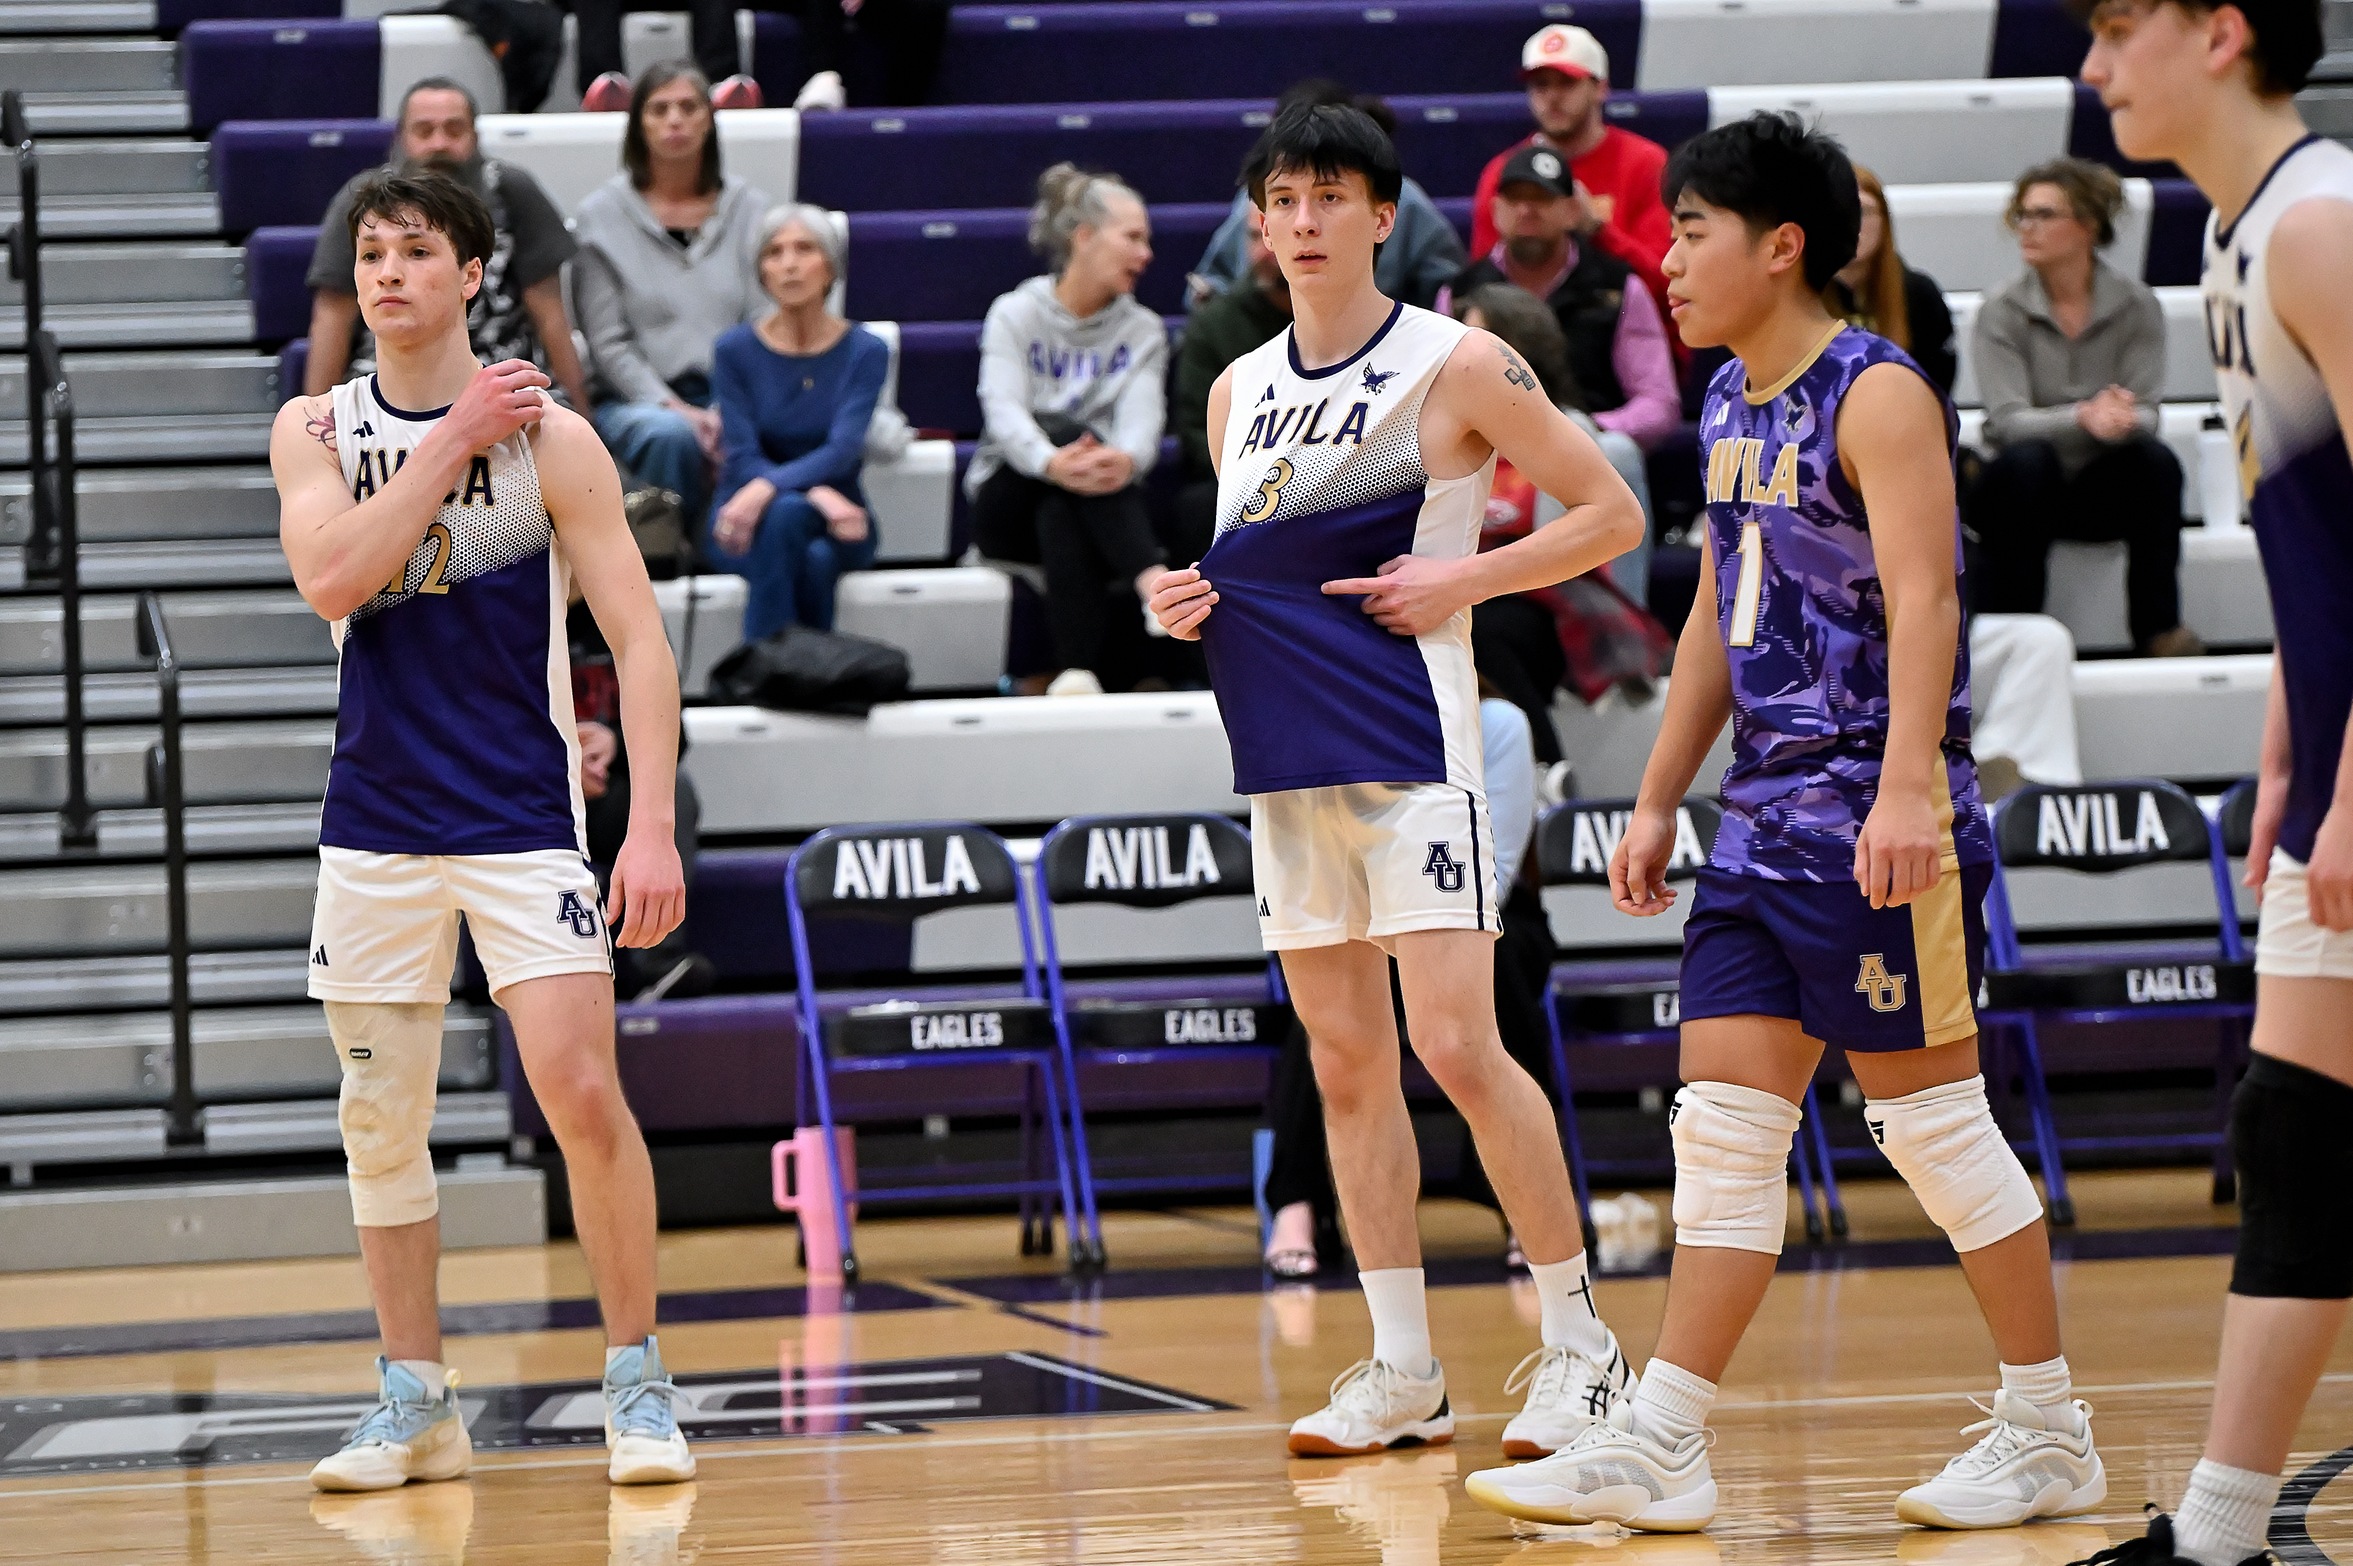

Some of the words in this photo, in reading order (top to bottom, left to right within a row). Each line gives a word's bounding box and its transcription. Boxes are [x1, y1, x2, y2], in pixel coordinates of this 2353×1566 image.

[1237, 396, 1371, 460] AVILA
[354, 448, 496, 508] AVA
[1242, 457, 1294, 524] 3
[1706, 437, 1799, 507] AVILA
[1728, 521, 1763, 647] 1
[1570, 805, 1707, 873] AVA
[2037, 791, 2170, 856] AVILA
[832, 834, 982, 899] AVILA
[1084, 824, 1221, 890] AVILA
[1422, 841, 1466, 893] AU
[556, 889, 599, 939] AU
[1855, 953, 1907, 1013] AU
[2126, 964, 2218, 1004] EAGLES
[910, 1011, 1004, 1051] EAGLES
[1165, 1008, 1257, 1045] EAGLES
